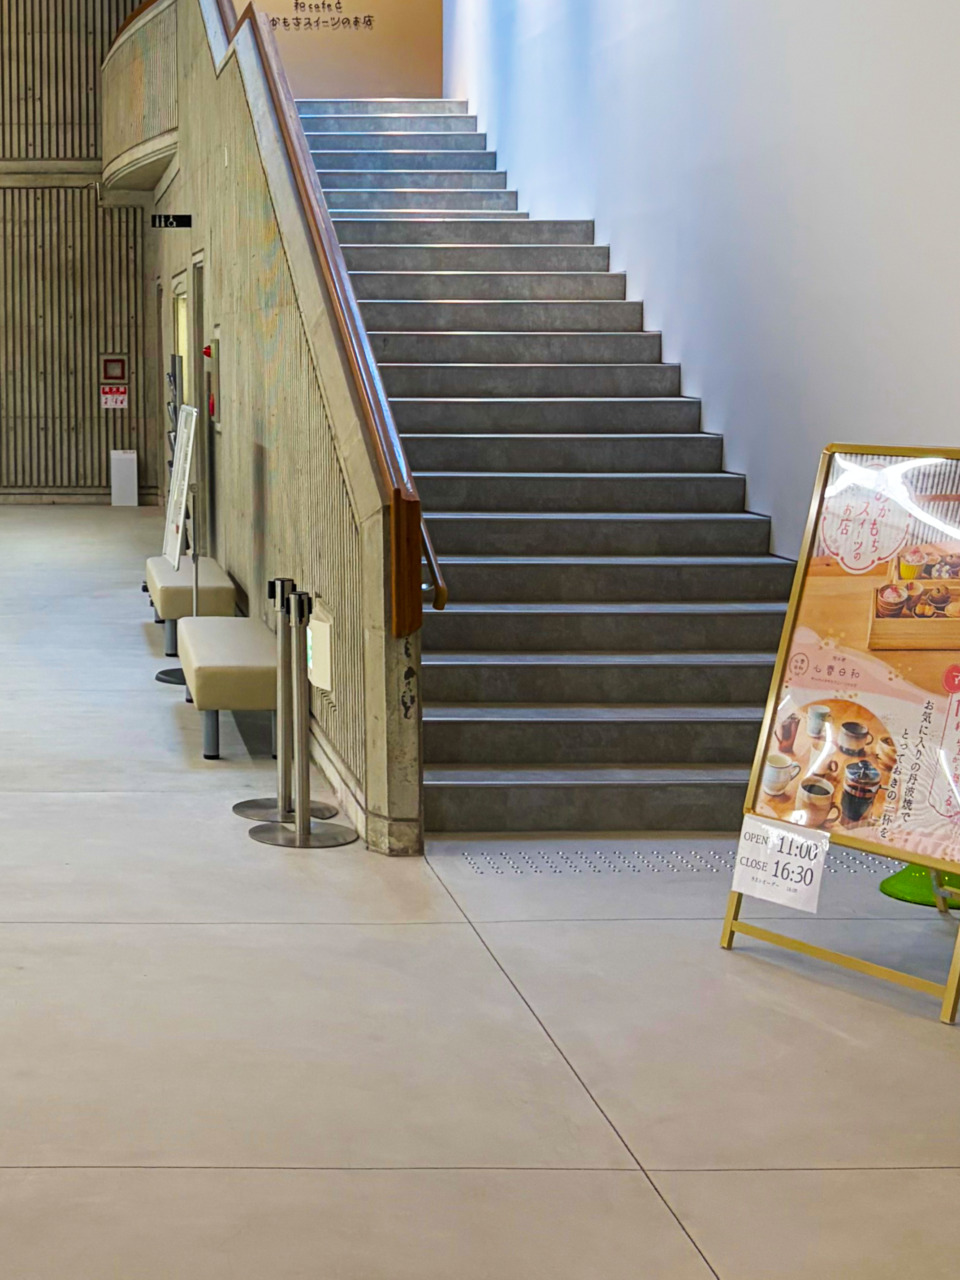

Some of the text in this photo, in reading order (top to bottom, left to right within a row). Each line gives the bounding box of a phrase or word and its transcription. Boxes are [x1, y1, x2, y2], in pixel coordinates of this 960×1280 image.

[836, 503, 855, 536] お店
[901, 699, 935, 823] お気に入りの丹波焼で
[880, 728, 909, 839] とっておきの一杯を
[743, 831, 769, 845] OPEN
[777, 835, 818, 861] 11:00
[740, 856, 769, 872] CLOSE
[772, 860, 814, 887] 16:30
